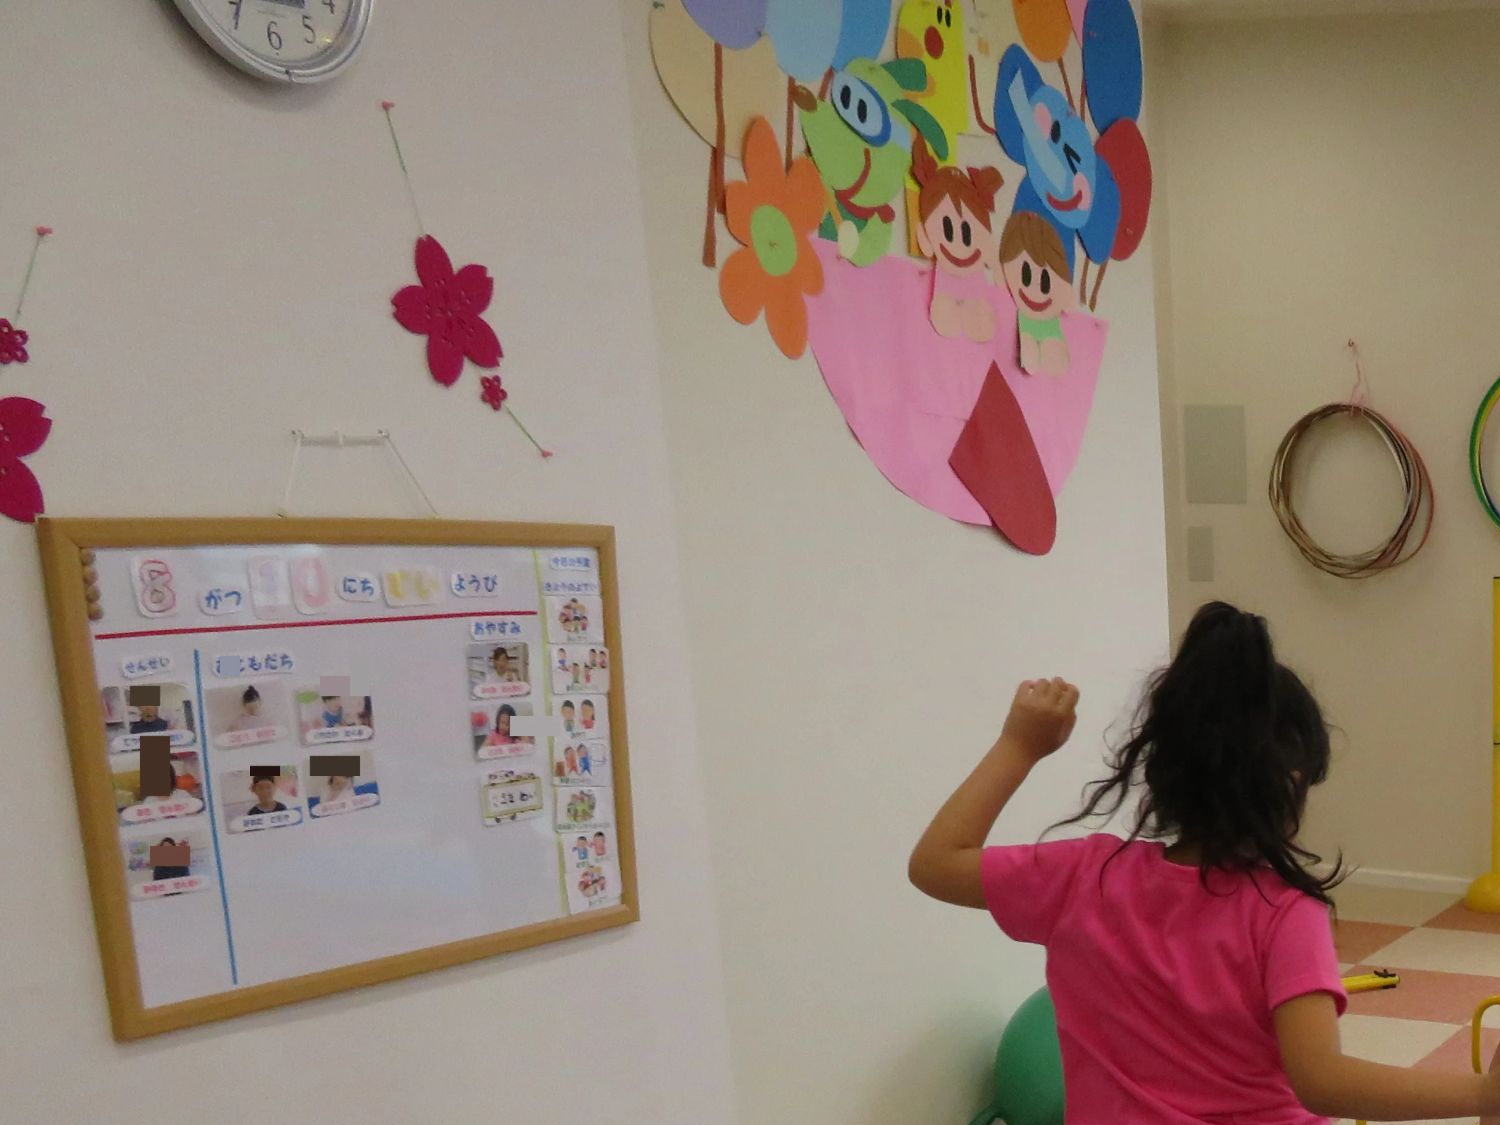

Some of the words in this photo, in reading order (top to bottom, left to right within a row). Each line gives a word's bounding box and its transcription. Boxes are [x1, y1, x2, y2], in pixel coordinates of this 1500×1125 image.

[266, 20, 283, 51] 6
[302, 14, 316, 44] 5
[139, 559, 177, 613] 8
[205, 588, 242, 610] がつ
[343, 577, 375, 595] にち
[453, 574, 498, 592] ようび
[473, 620, 522, 636] おやすみ
[125, 655, 171, 674] せんせい
